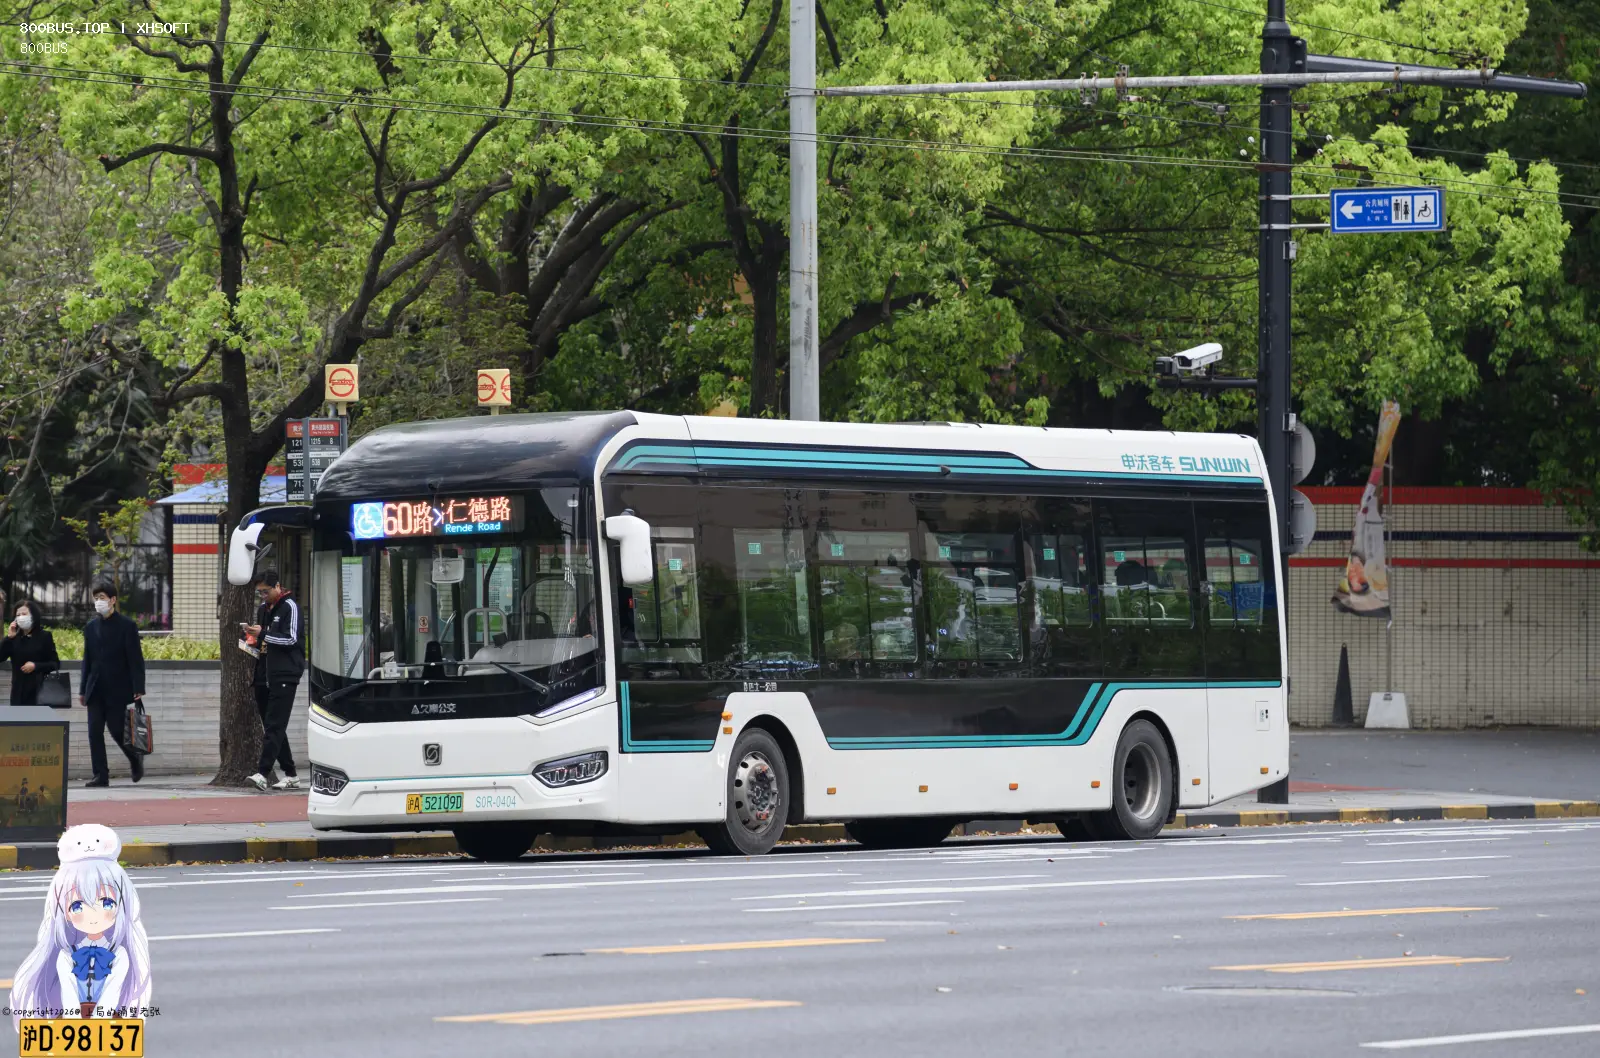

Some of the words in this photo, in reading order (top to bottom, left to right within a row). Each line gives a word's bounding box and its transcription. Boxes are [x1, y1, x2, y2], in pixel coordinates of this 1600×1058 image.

[329, 436, 334, 445] 8
[1121, 454, 1176, 472] 申沃客车
[1178, 456, 1251, 473] SUNWIN
[383, 501, 434, 536] 60路
[446, 496, 512, 524] 仁德路
[445, 523, 473, 533] Rende
[478, 521, 501, 532] Road
